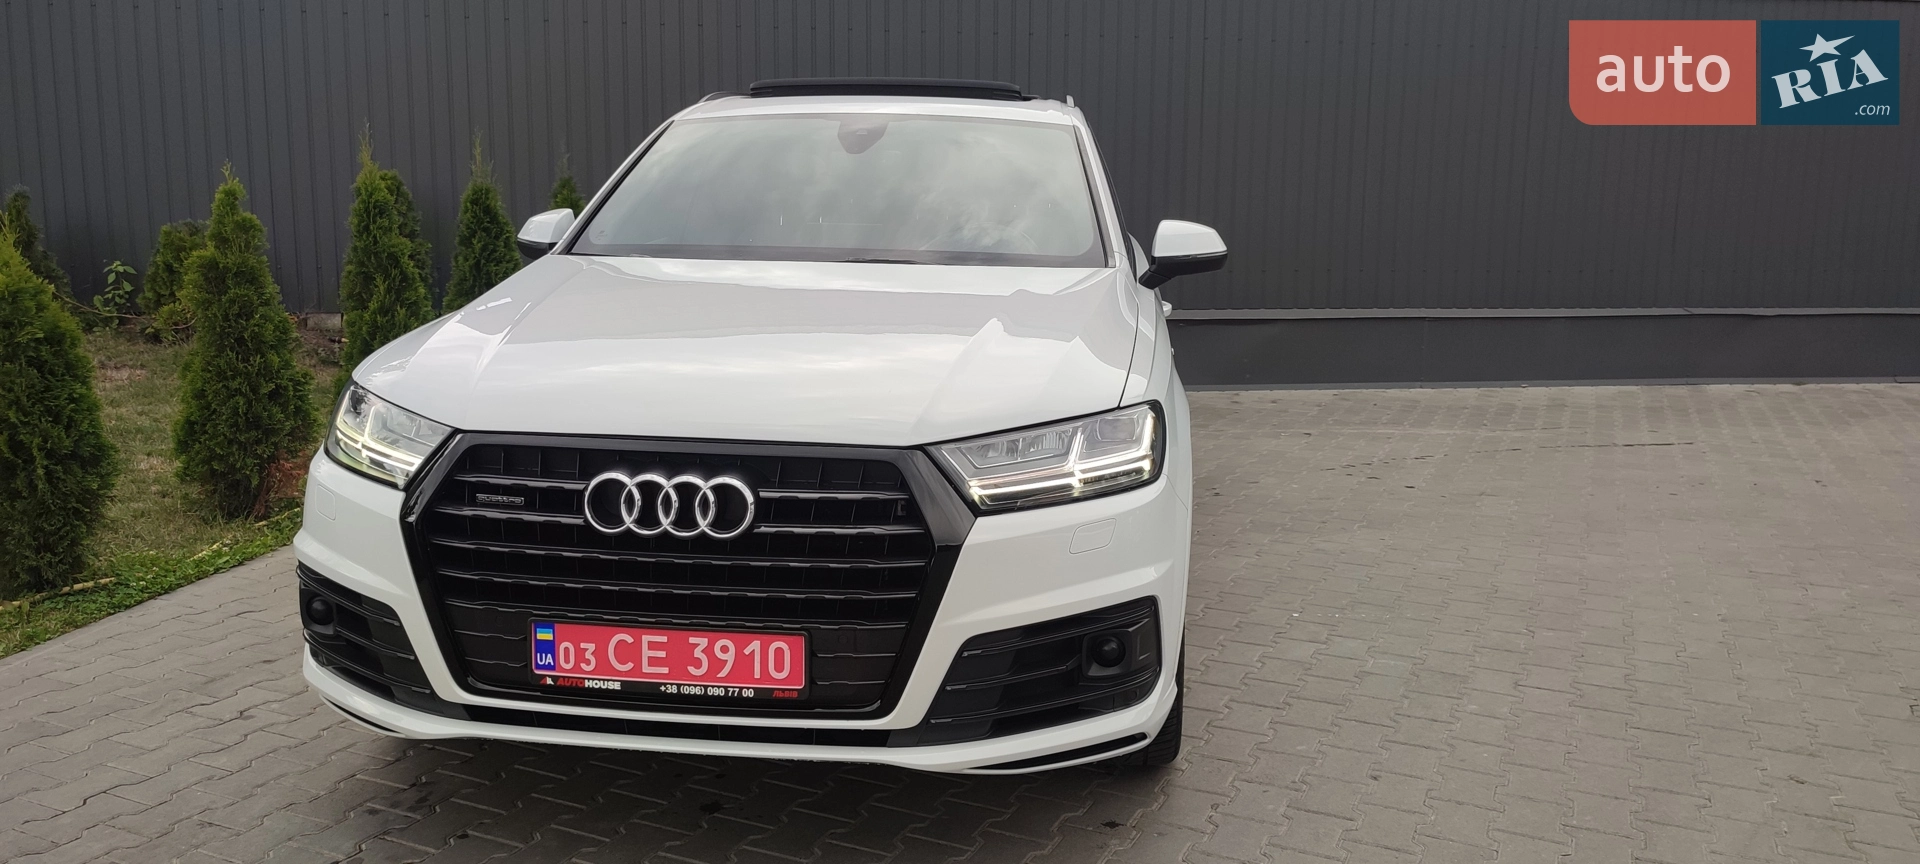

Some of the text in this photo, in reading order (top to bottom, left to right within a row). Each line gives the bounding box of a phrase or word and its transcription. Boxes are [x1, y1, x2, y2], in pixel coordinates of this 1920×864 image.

[537, 652, 554, 666] UA
[559, 633, 791, 680] 03 CE 3910
[556, 677, 622, 690] AUTOHOUSE
[659, 684, 755, 698] +38 (096) 090 77 00
[772, 690, 798, 699] ЛЬВІВ
